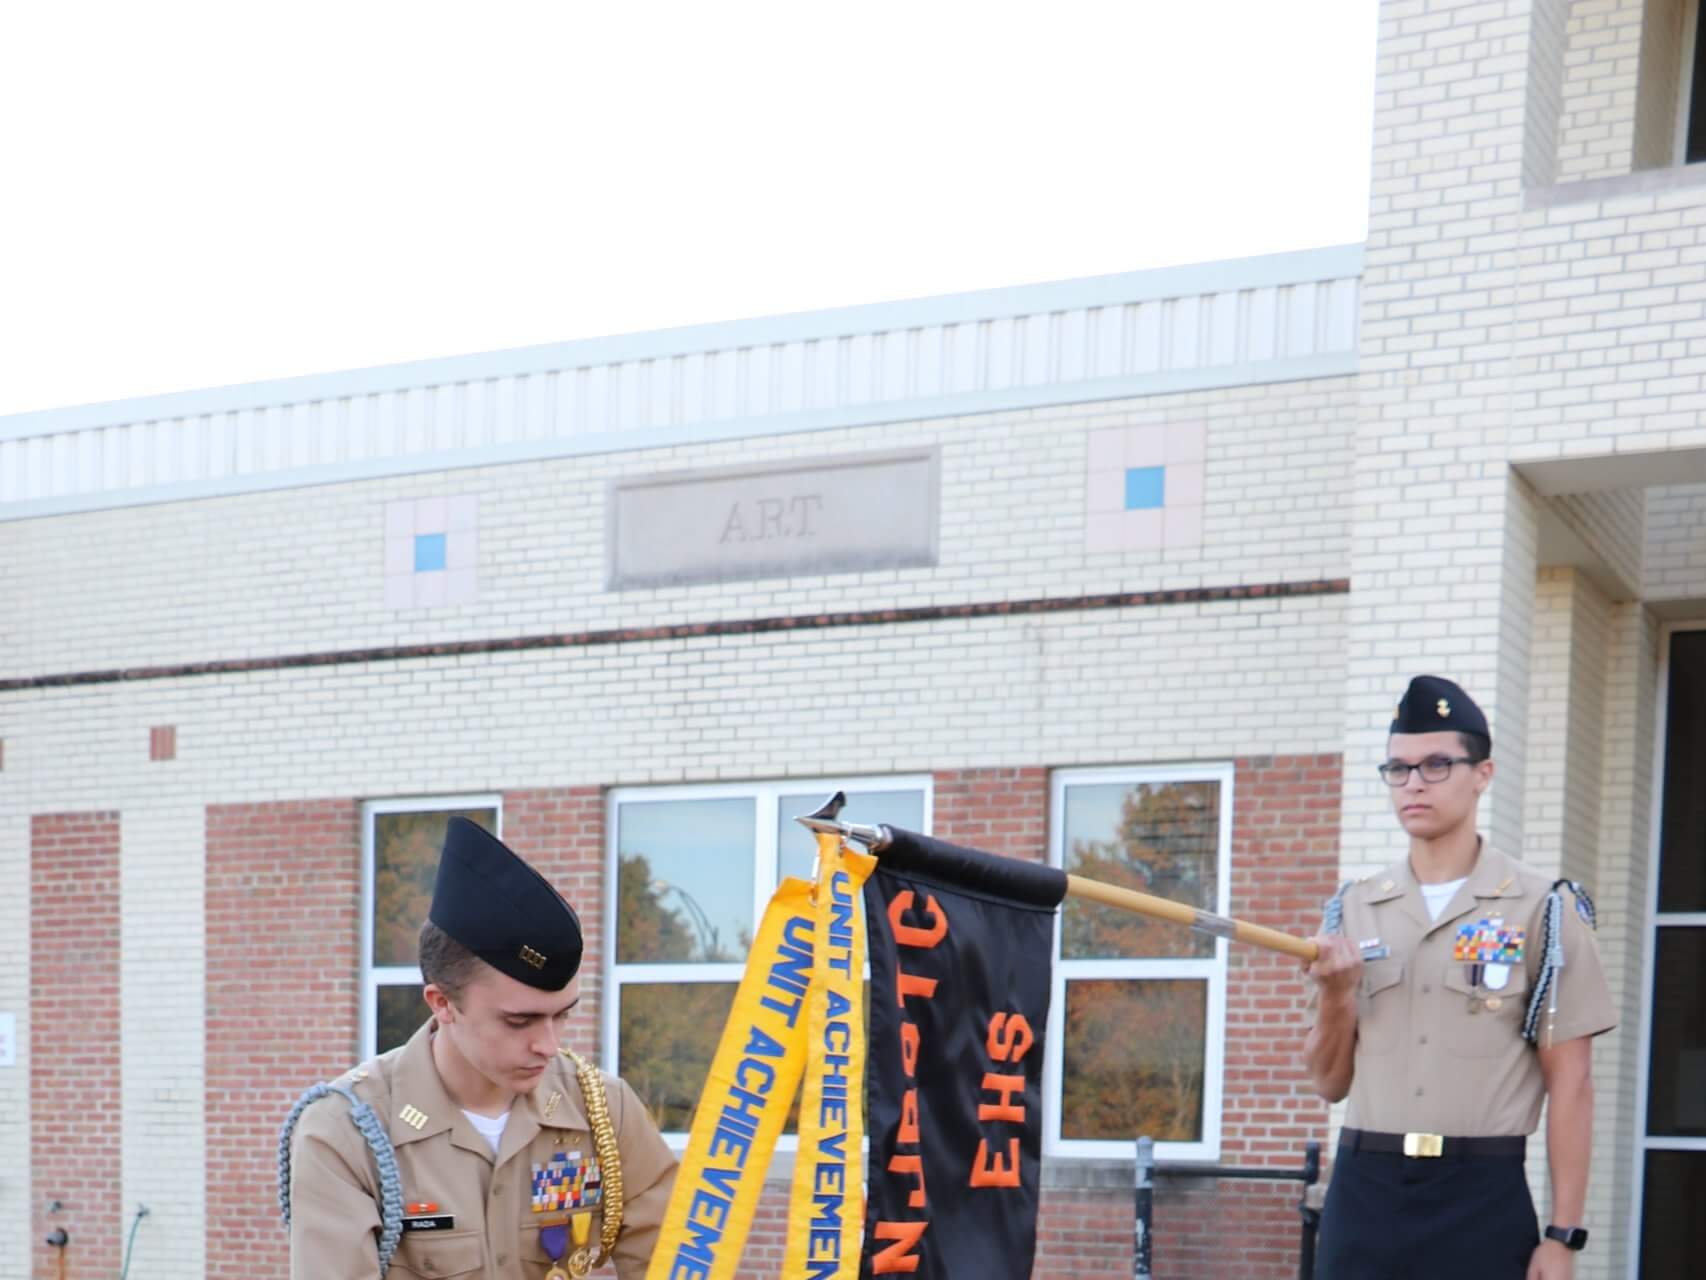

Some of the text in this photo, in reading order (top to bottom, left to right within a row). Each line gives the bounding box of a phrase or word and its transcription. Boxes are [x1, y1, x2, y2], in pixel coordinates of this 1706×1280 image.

[719, 494, 824, 544] ART
[760, 915, 816, 1029] UNIT
[828, 870, 853, 979] UNIT
[969, 1012, 1034, 1187] EHS
